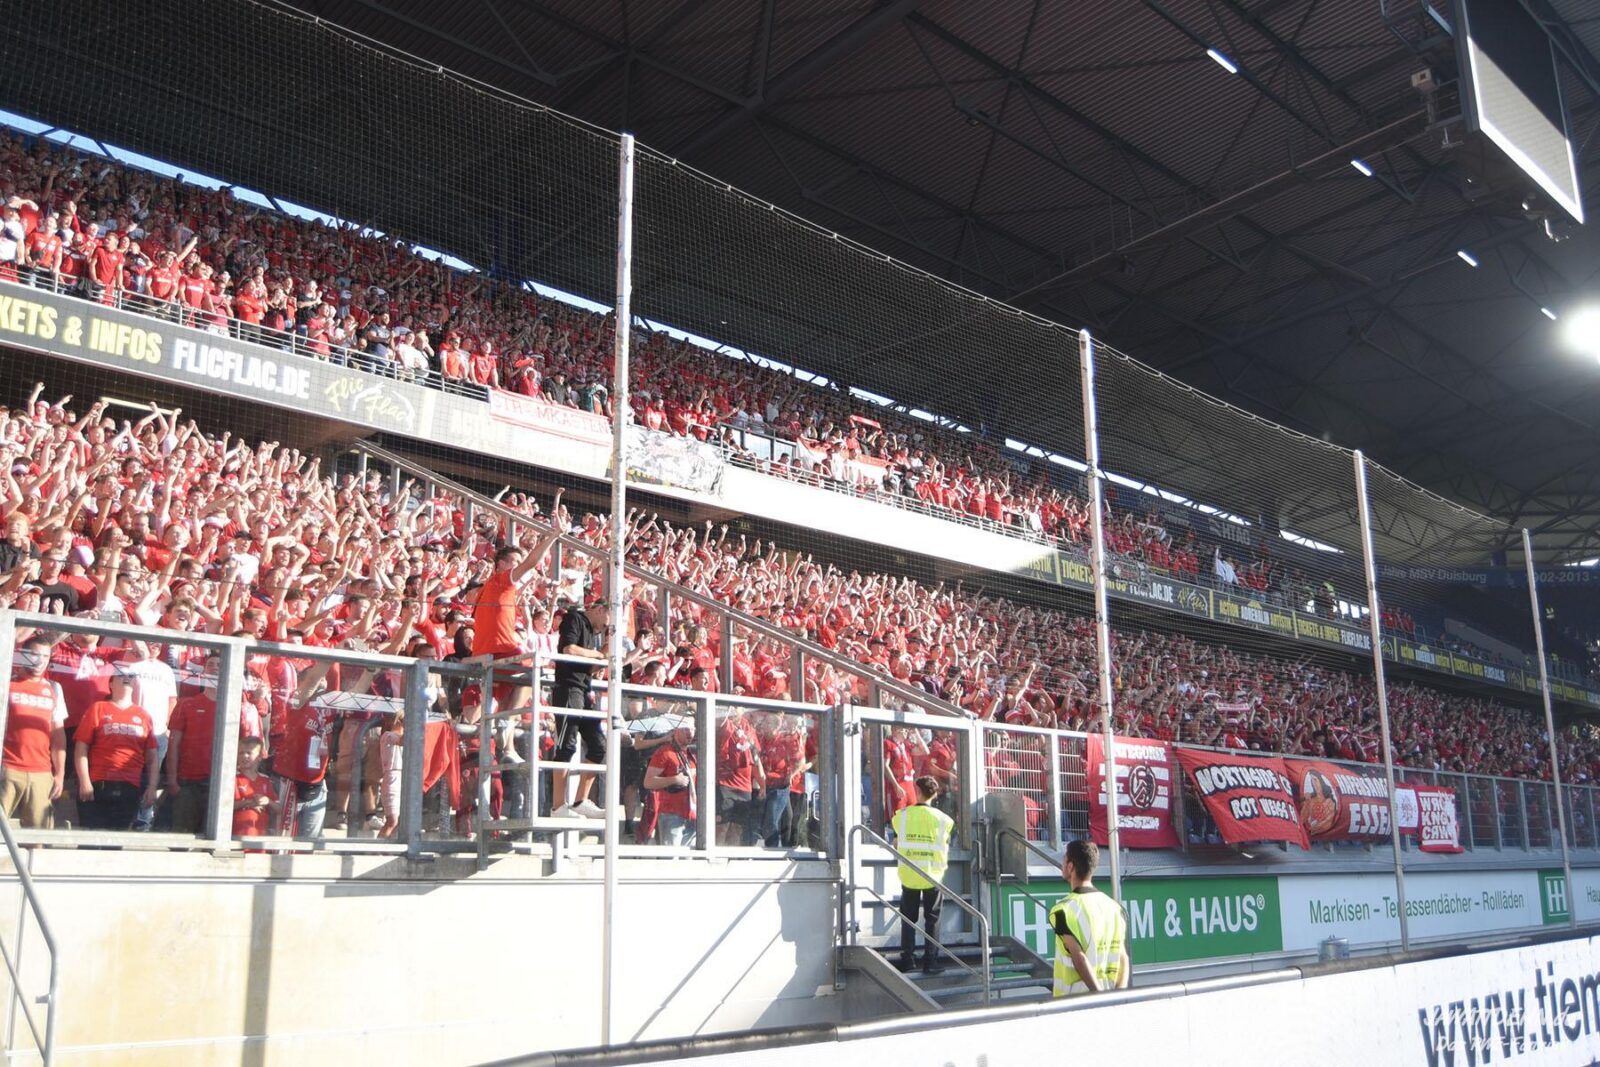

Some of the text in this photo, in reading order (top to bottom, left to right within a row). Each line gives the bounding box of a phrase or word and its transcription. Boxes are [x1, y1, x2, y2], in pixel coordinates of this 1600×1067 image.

[63, 315, 83, 346] &
[90, 317, 163, 364] INFOS
[173, 337, 310, 399] FLICFLAC.DE
[1061, 559, 1095, 585] TICKETS
[1438, 568, 1487, 584] Duisburg
[1195, 765, 1281, 795] NORTHSIDE
[1230, 797, 1259, 820] ROT
[1164, 898, 1183, 937] &
[1309, 899, 1370, 924] Markisen
